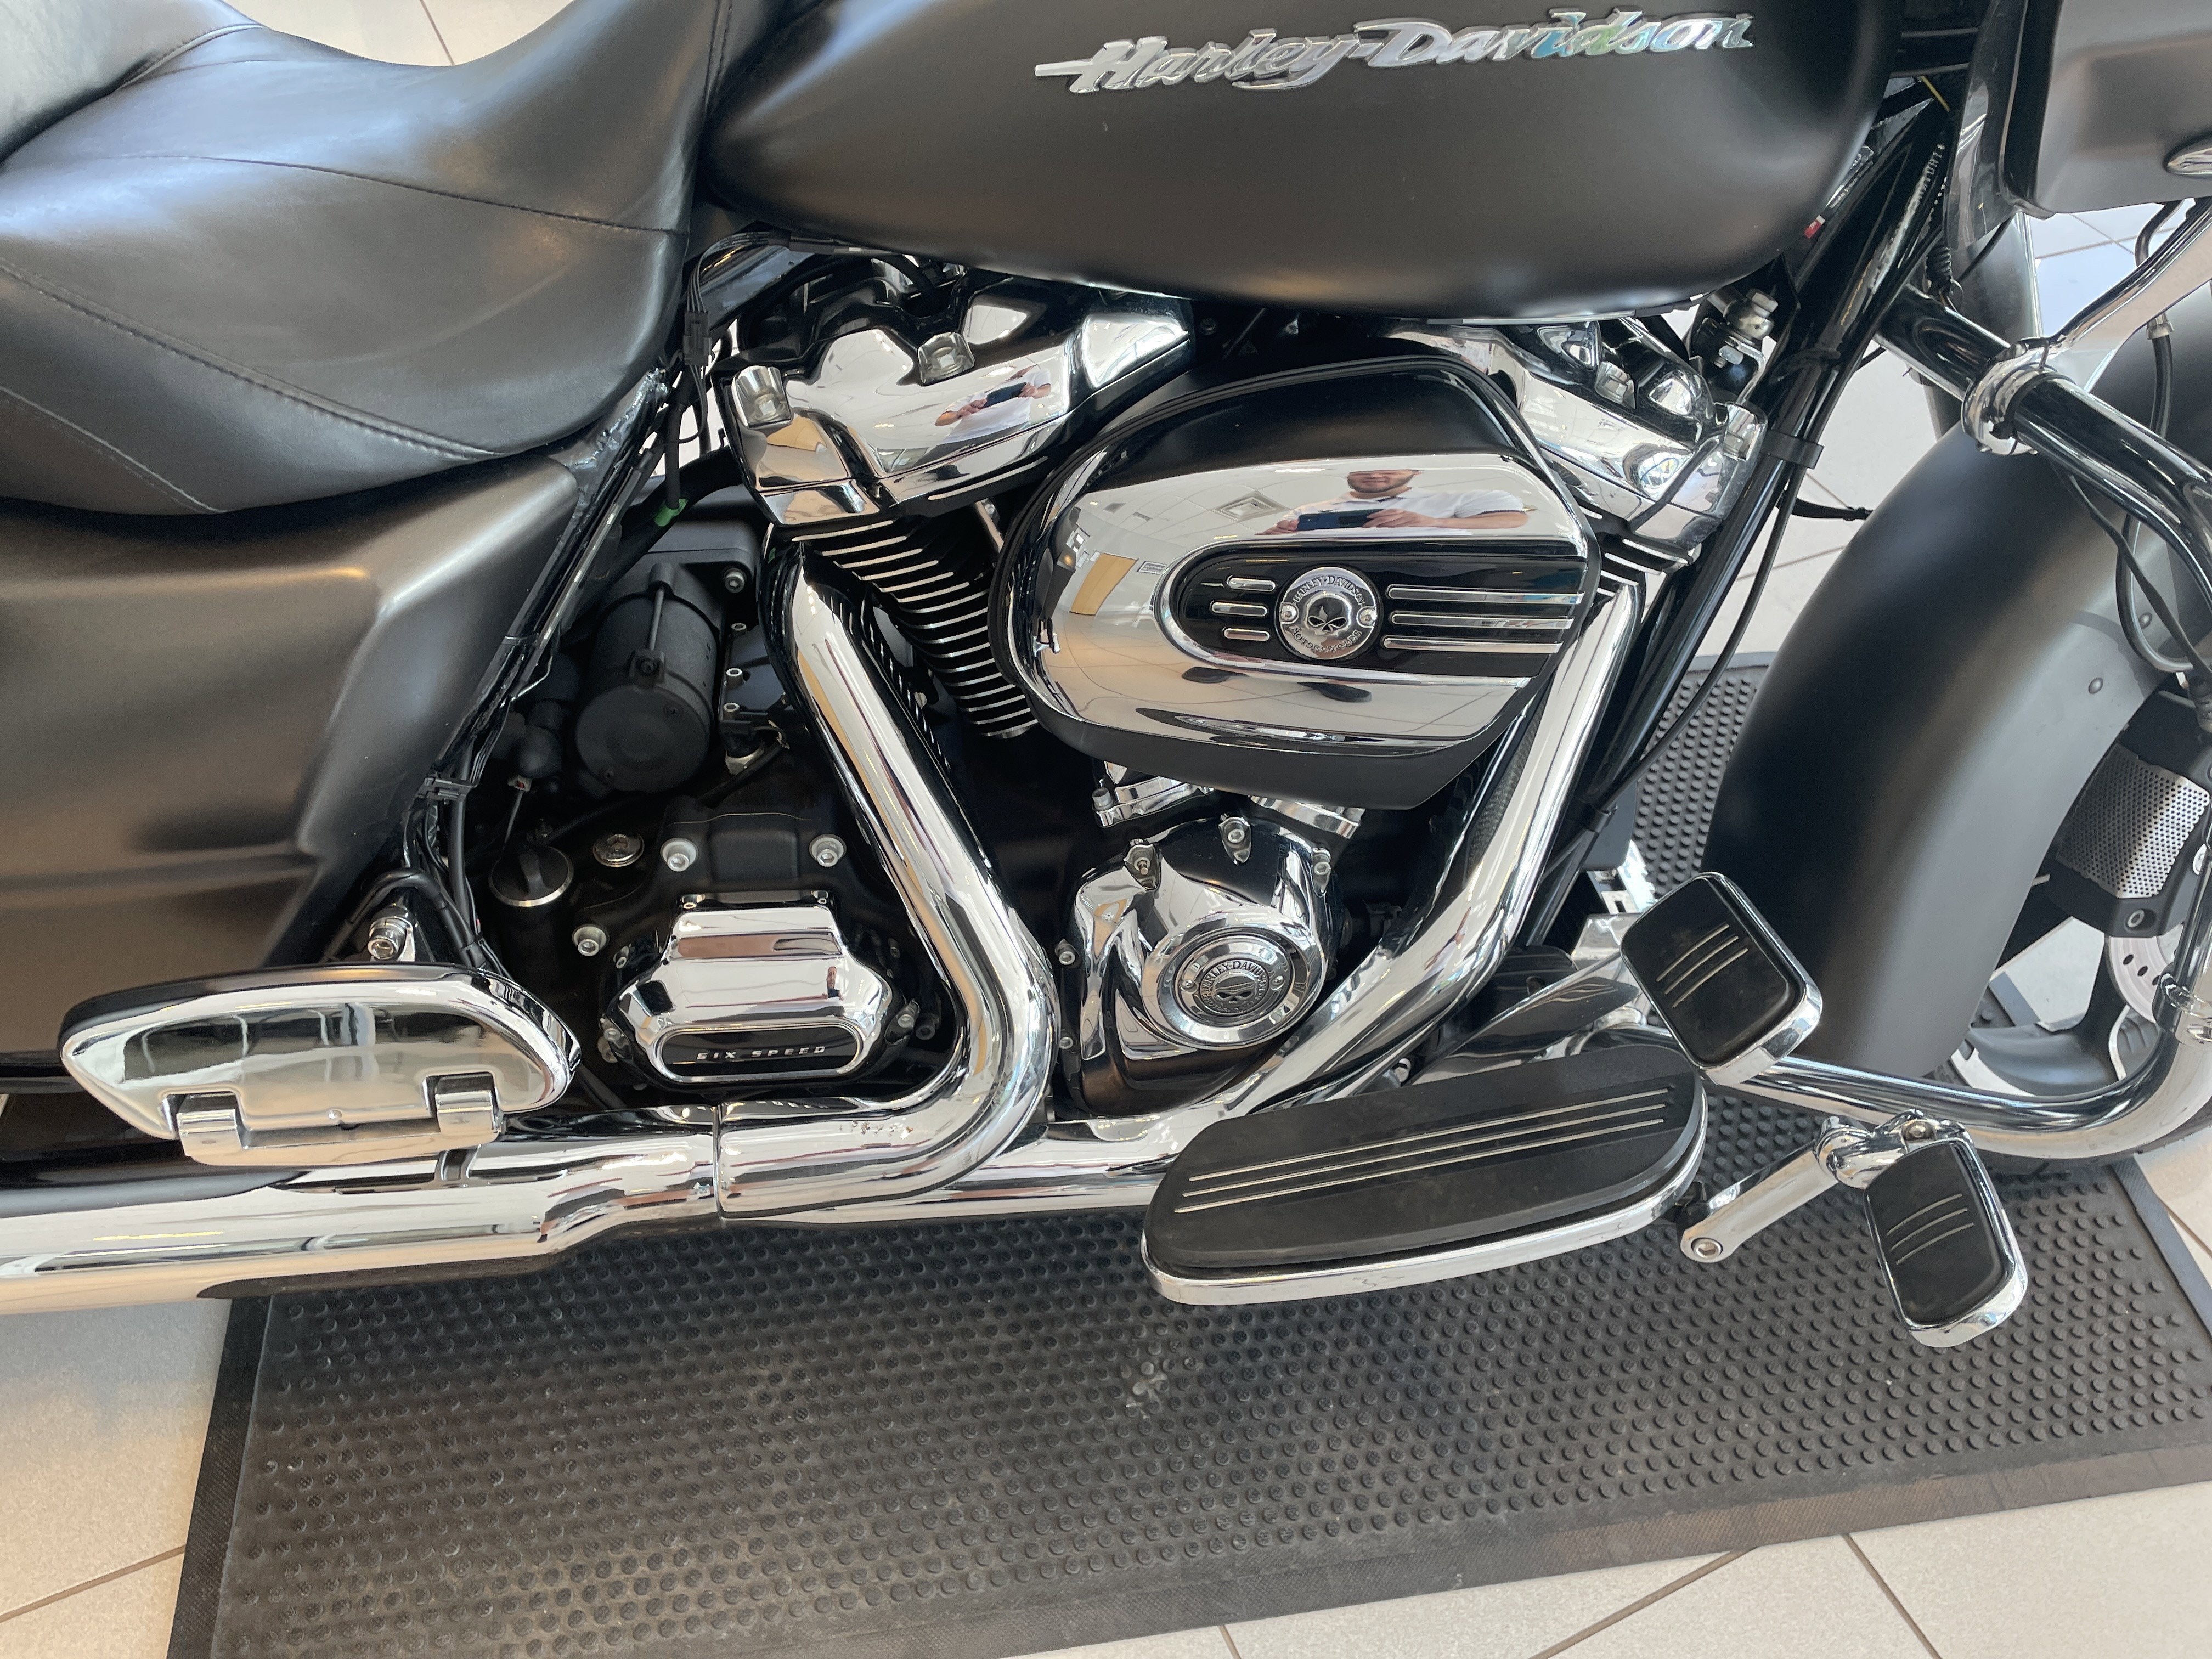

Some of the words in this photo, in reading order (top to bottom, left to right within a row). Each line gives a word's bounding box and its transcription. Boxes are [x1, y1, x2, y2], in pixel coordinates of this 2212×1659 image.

[1035, 7, 1754, 94] Harley-Davidson
[1292, 575, 1366, 607] HARLEY-DAVIDSON
[1201, 960, 1267, 992] HARLEY-DAVIDSON
[696, 1051, 737, 1060] SIX
[751, 1045, 826, 1058] SPEED
